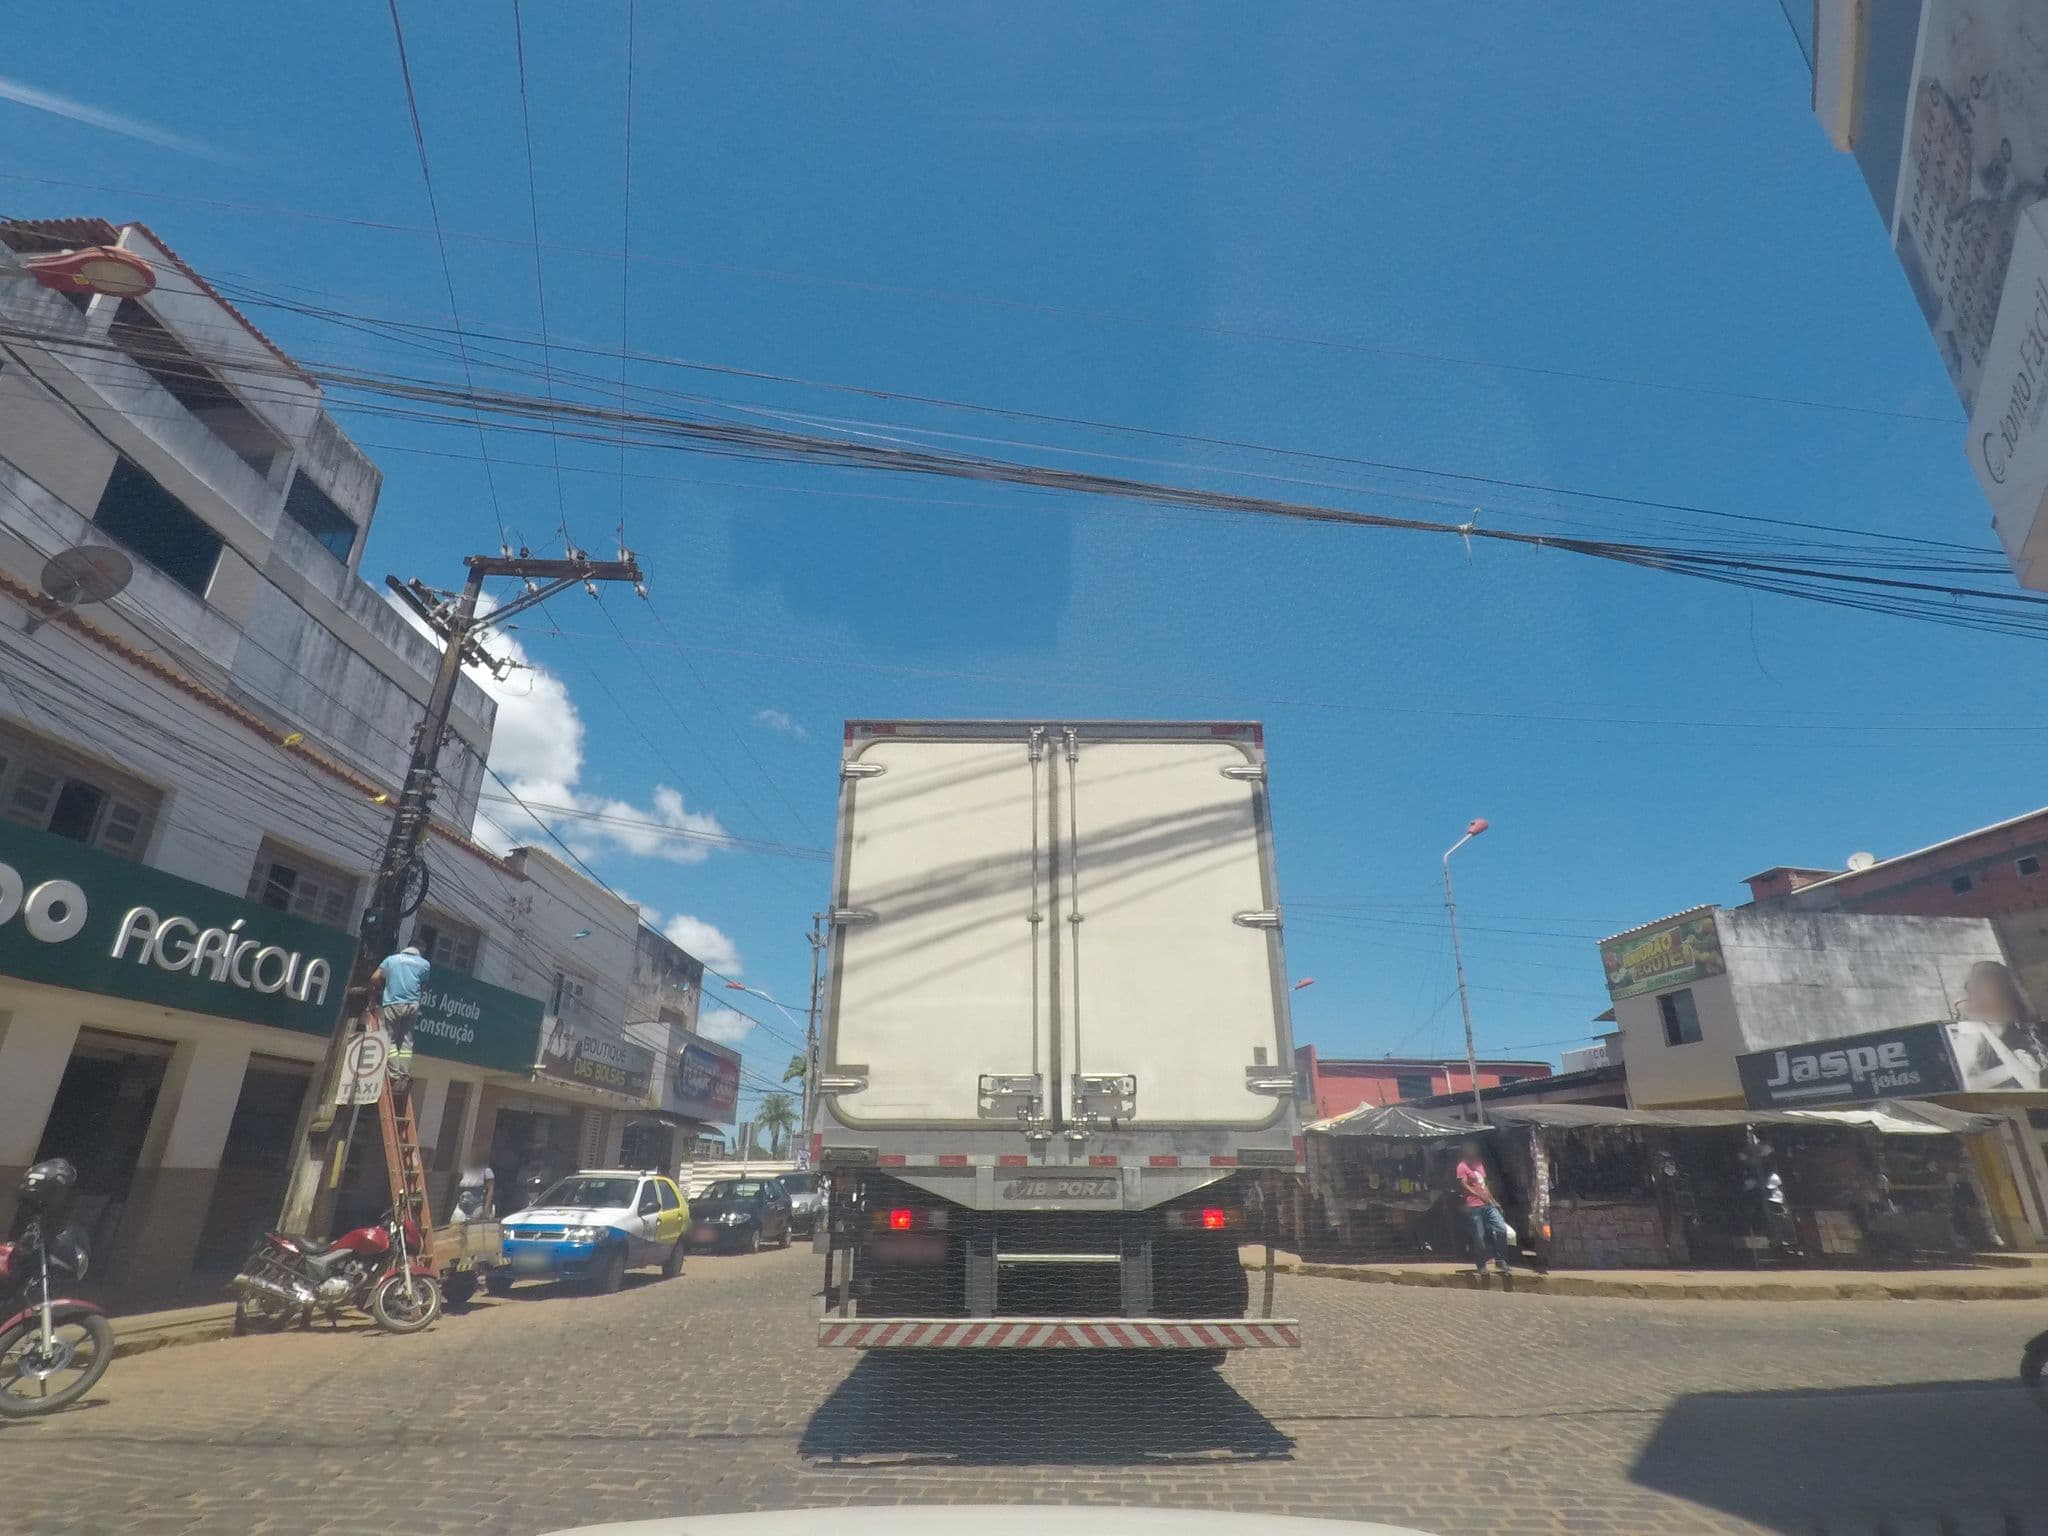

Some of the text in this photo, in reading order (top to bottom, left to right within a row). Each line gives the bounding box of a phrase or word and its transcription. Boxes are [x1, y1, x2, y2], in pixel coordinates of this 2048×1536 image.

[112, 906, 331, 1006] AGRÍCOLA
[439, 991, 481, 1021] Agrícola
[414, 1018, 475, 1045] onstrução
[357, 1044, 377, 1069] E
[584, 1036, 626, 1062] BOUTIQUE
[1767, 1041, 1910, 1087] Jaspe
[1872, 1066, 1921, 1097] joias
